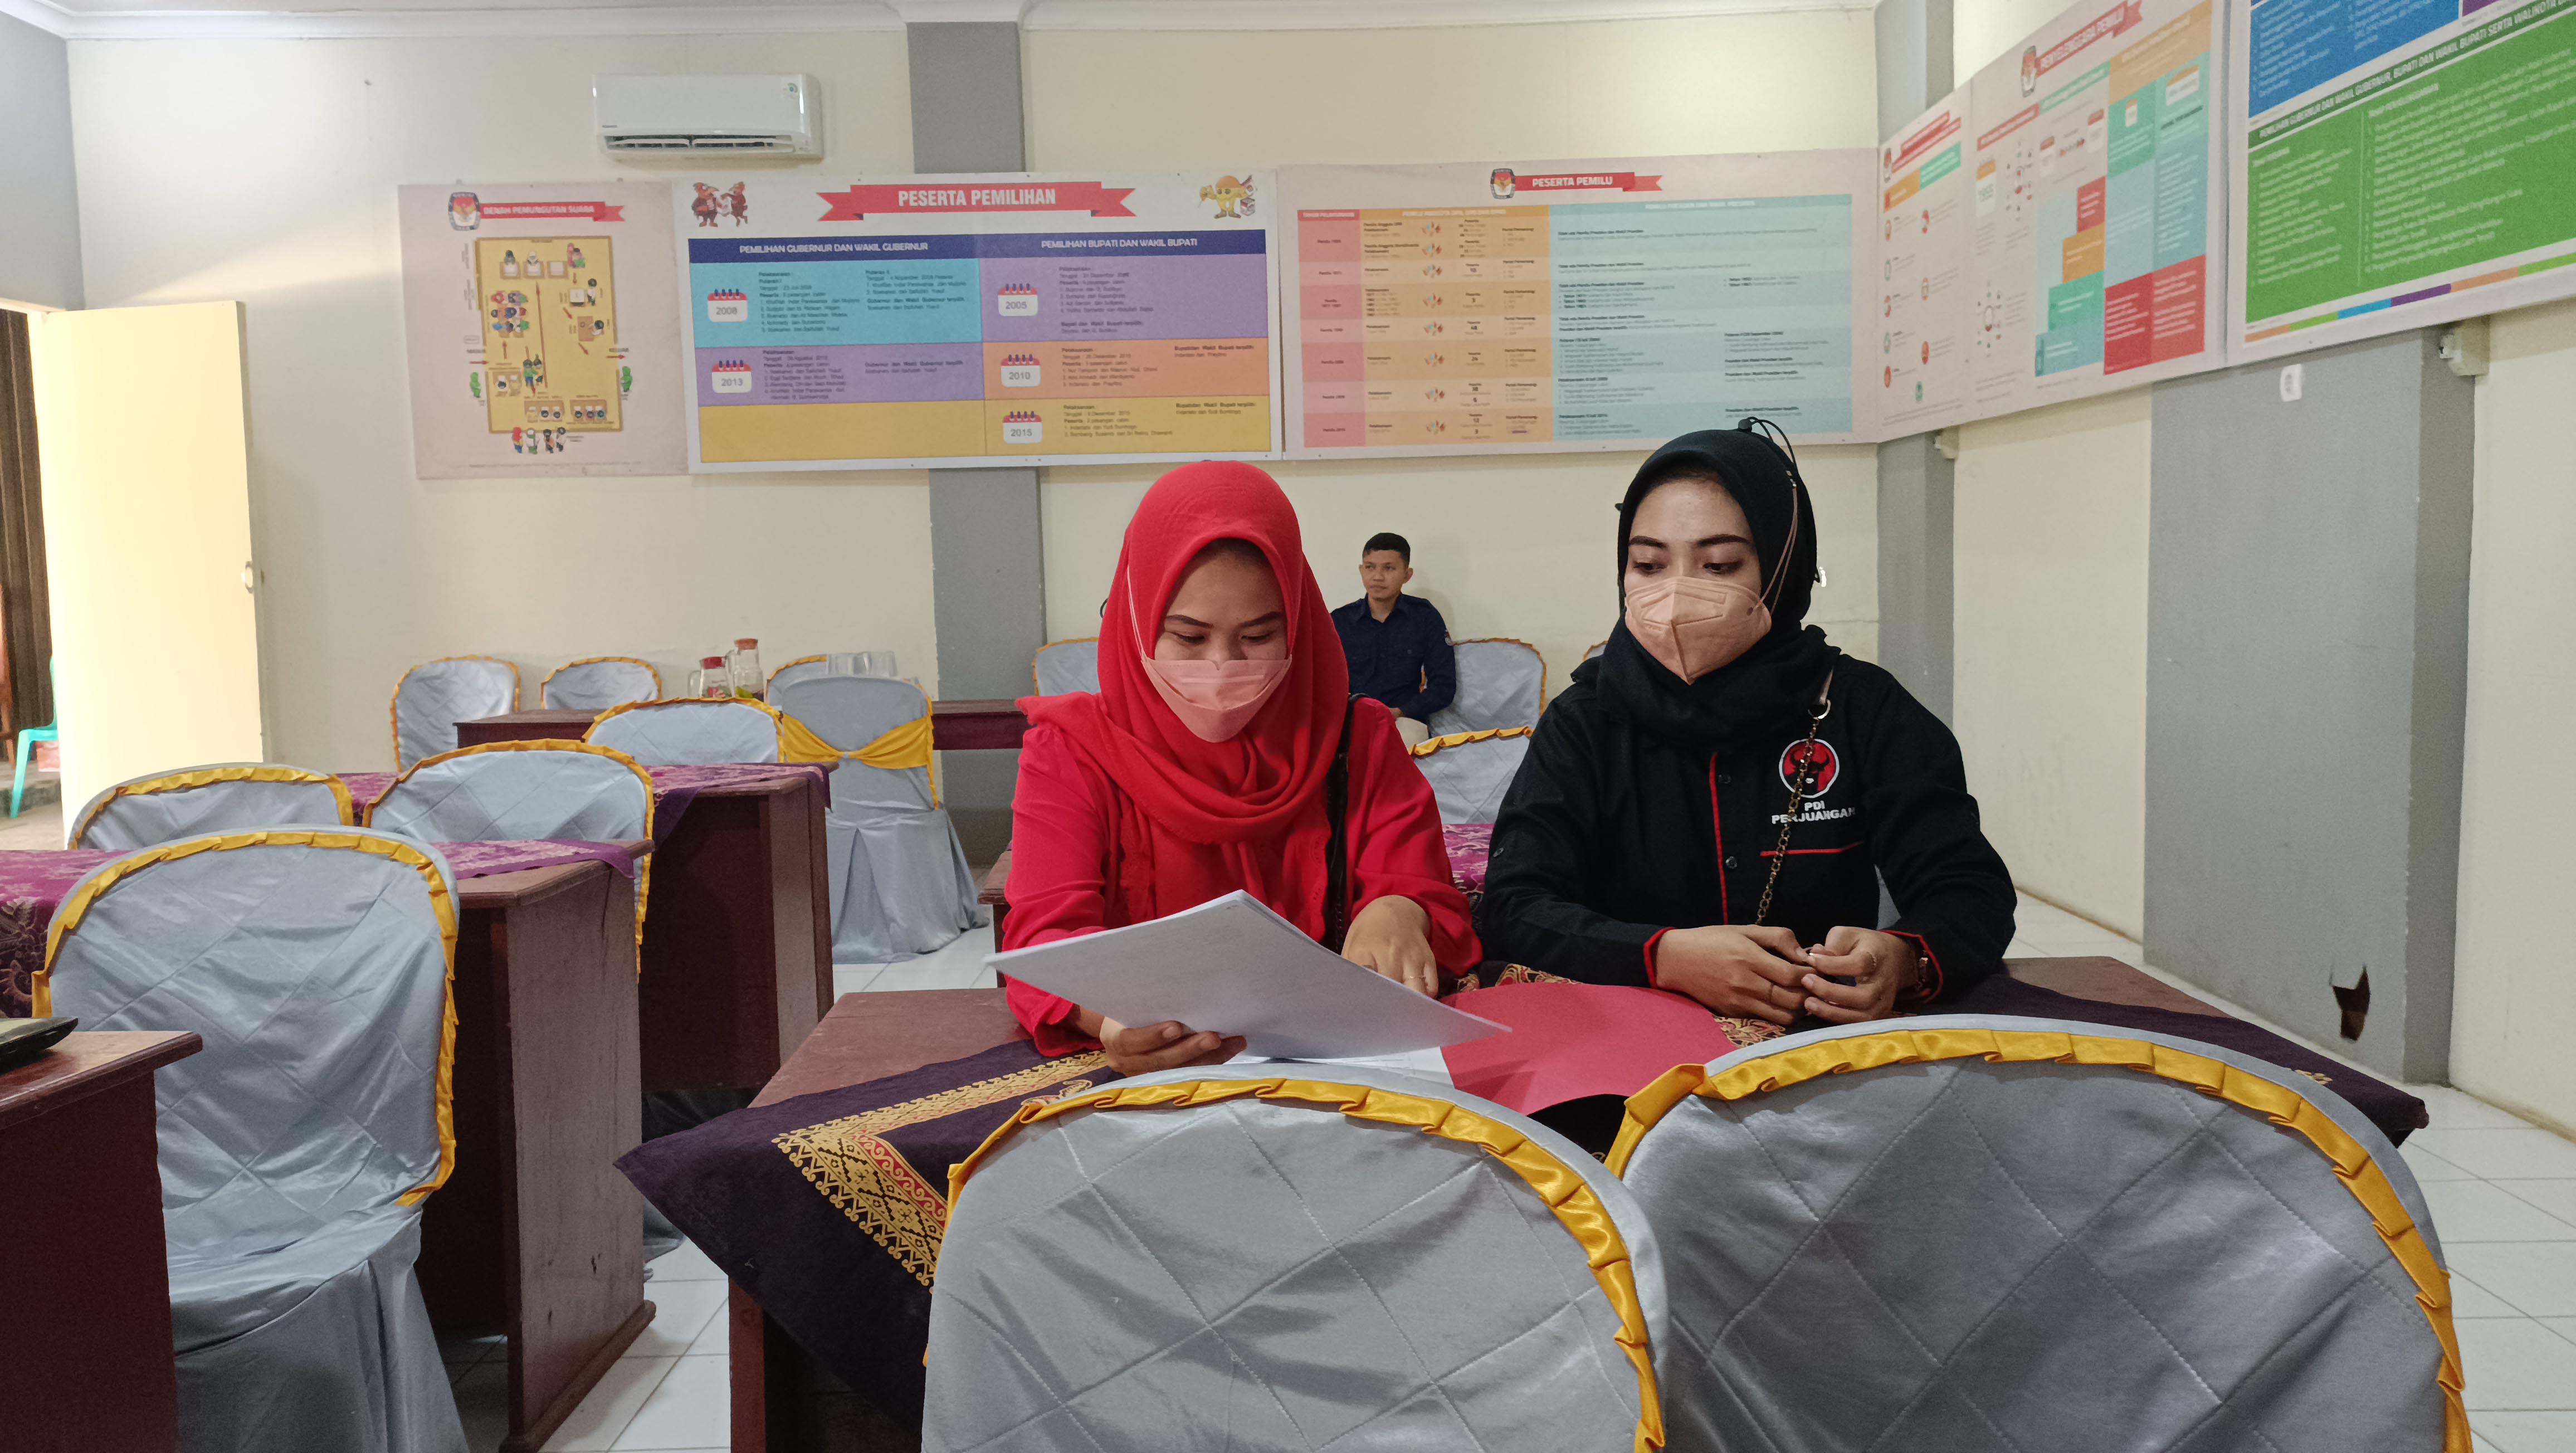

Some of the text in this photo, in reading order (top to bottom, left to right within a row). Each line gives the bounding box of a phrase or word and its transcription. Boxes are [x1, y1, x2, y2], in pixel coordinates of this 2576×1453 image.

[2487, 17, 2513, 36] SERTA
[1533, 177, 1613, 187] PESERTA PEMILU
[898, 189, 1056, 206] PESERTA PEMILIHAN
[1005, 301, 1027, 310] 2005
[715, 307, 738, 315] 2008
[1009, 372, 1031, 381] 2010
[721, 378, 743, 387] 2013
[1010, 428, 1032, 437] 2015
[1804, 801, 1824, 811] PDI
